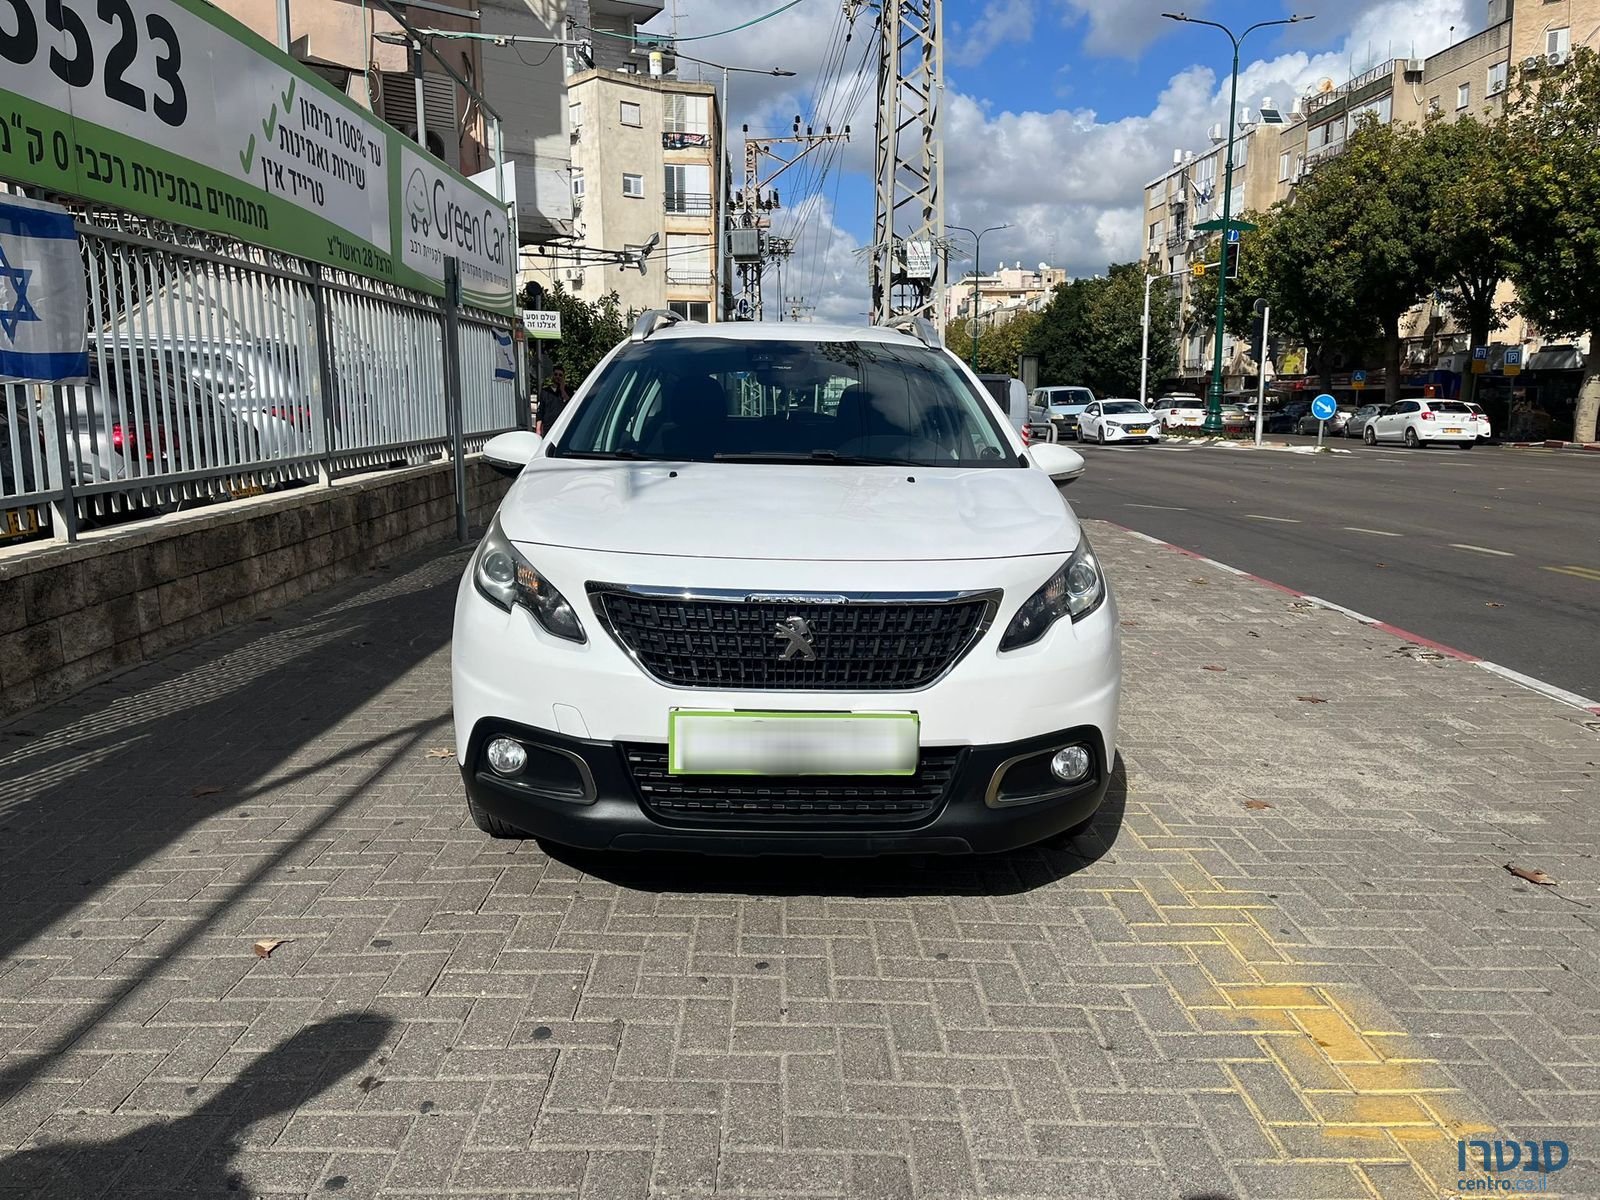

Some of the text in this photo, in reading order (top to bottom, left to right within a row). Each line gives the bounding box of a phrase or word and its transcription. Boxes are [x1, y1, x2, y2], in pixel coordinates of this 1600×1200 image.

[300, 97, 381, 167] עד 100% מימון
[75, 144, 127, 188] רכבי
[279, 124, 365, 190] שירות ואמינות
[132, 162, 203, 211] במכירת
[261, 156, 324, 206] טרייד אין
[206, 187, 269, 230] מתמחים
[433, 178, 505, 266] Green Car
[362, 247, 373, 269] 28
[374, 250, 393, 275] הרצל
[410, 239, 421, 255] רכב
[540, 313, 557, 321] שלם
